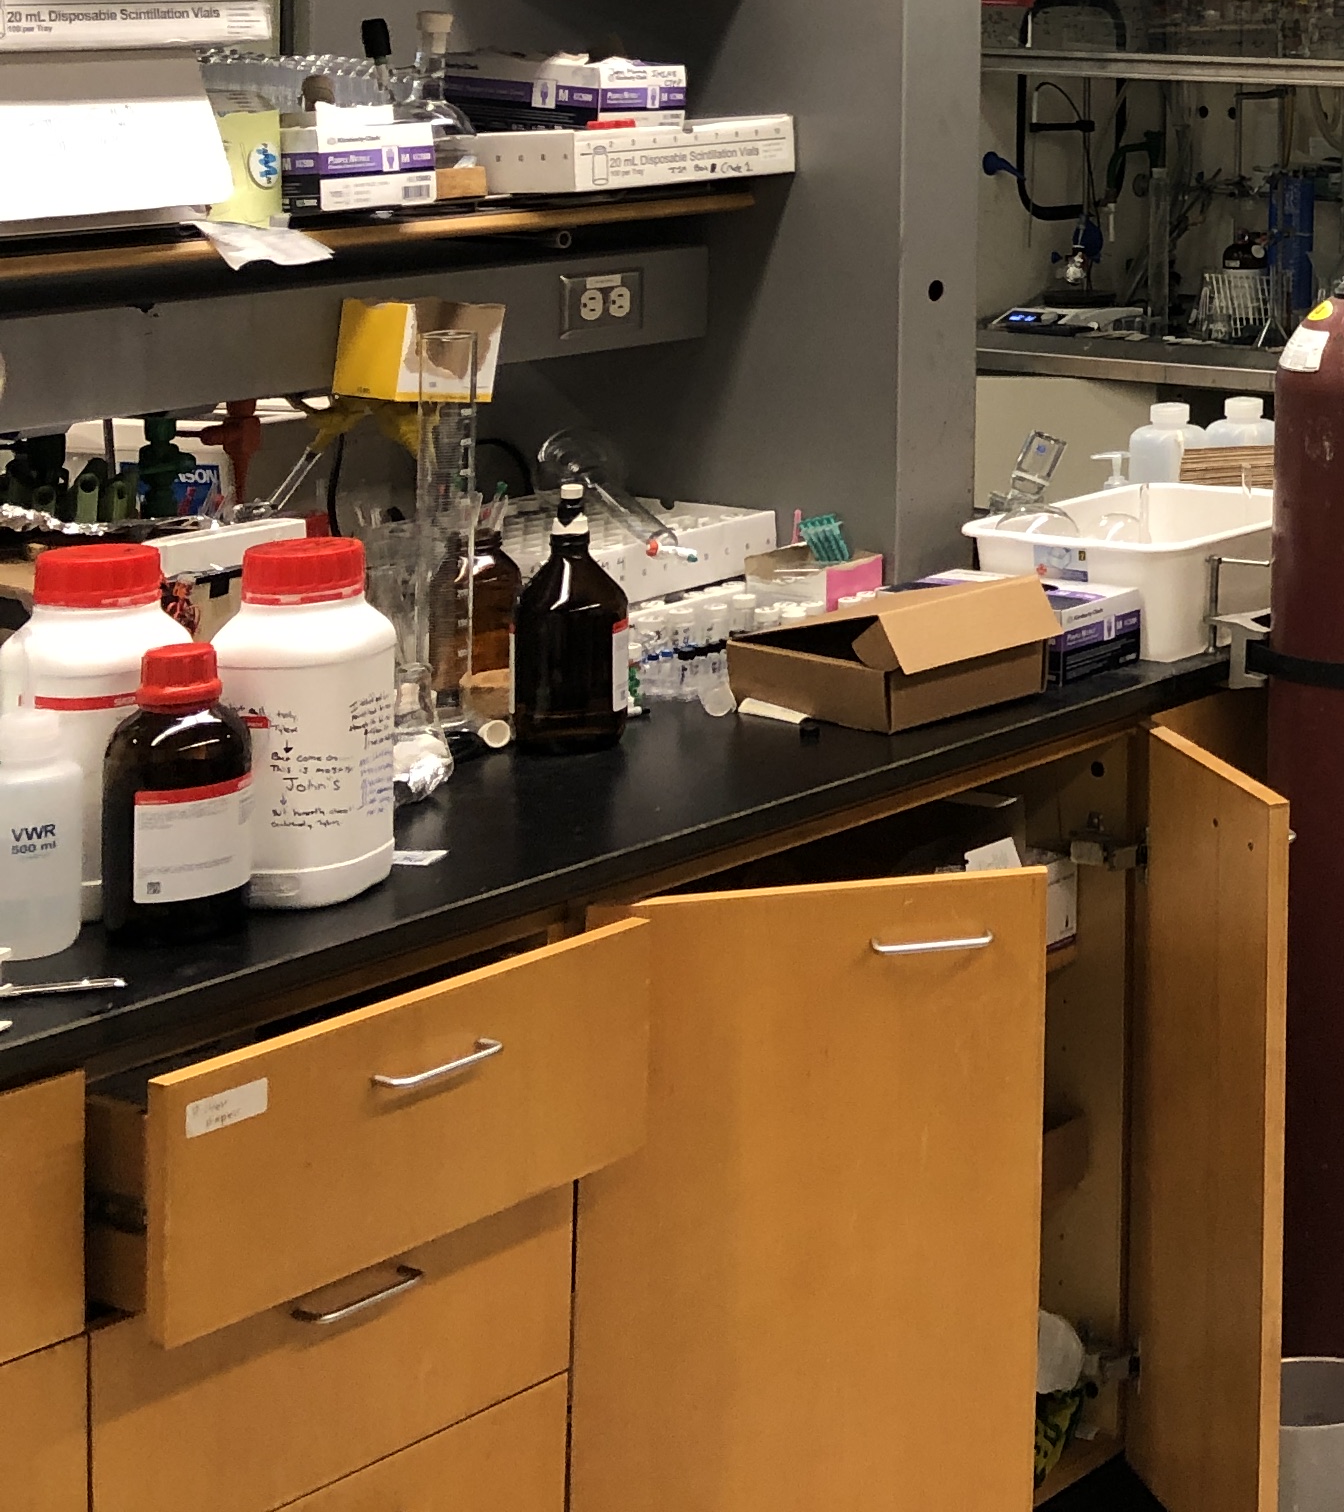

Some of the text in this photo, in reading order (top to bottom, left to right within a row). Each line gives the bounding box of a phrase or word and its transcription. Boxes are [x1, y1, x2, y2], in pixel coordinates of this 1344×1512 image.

[7, 7, 220, 23] 20 mL Disposable Scintillation Vials
[37, 24, 53, 33] Tray
[559, 89, 568, 101] M
[661, 93, 668, 101] M
[282, 157, 292, 170] M
[401, 153, 410, 163] M
[610, 147, 759, 168] 20 mL Disposable Scintillation Vials
[632, 168, 645, 176] Tray
[296, 754, 322, 762] come
[270, 764, 291, 774] This
[283, 777, 341, 792] John's
[11, 824, 56, 842] VWR
[12, 840, 56, 855] 500 ml
